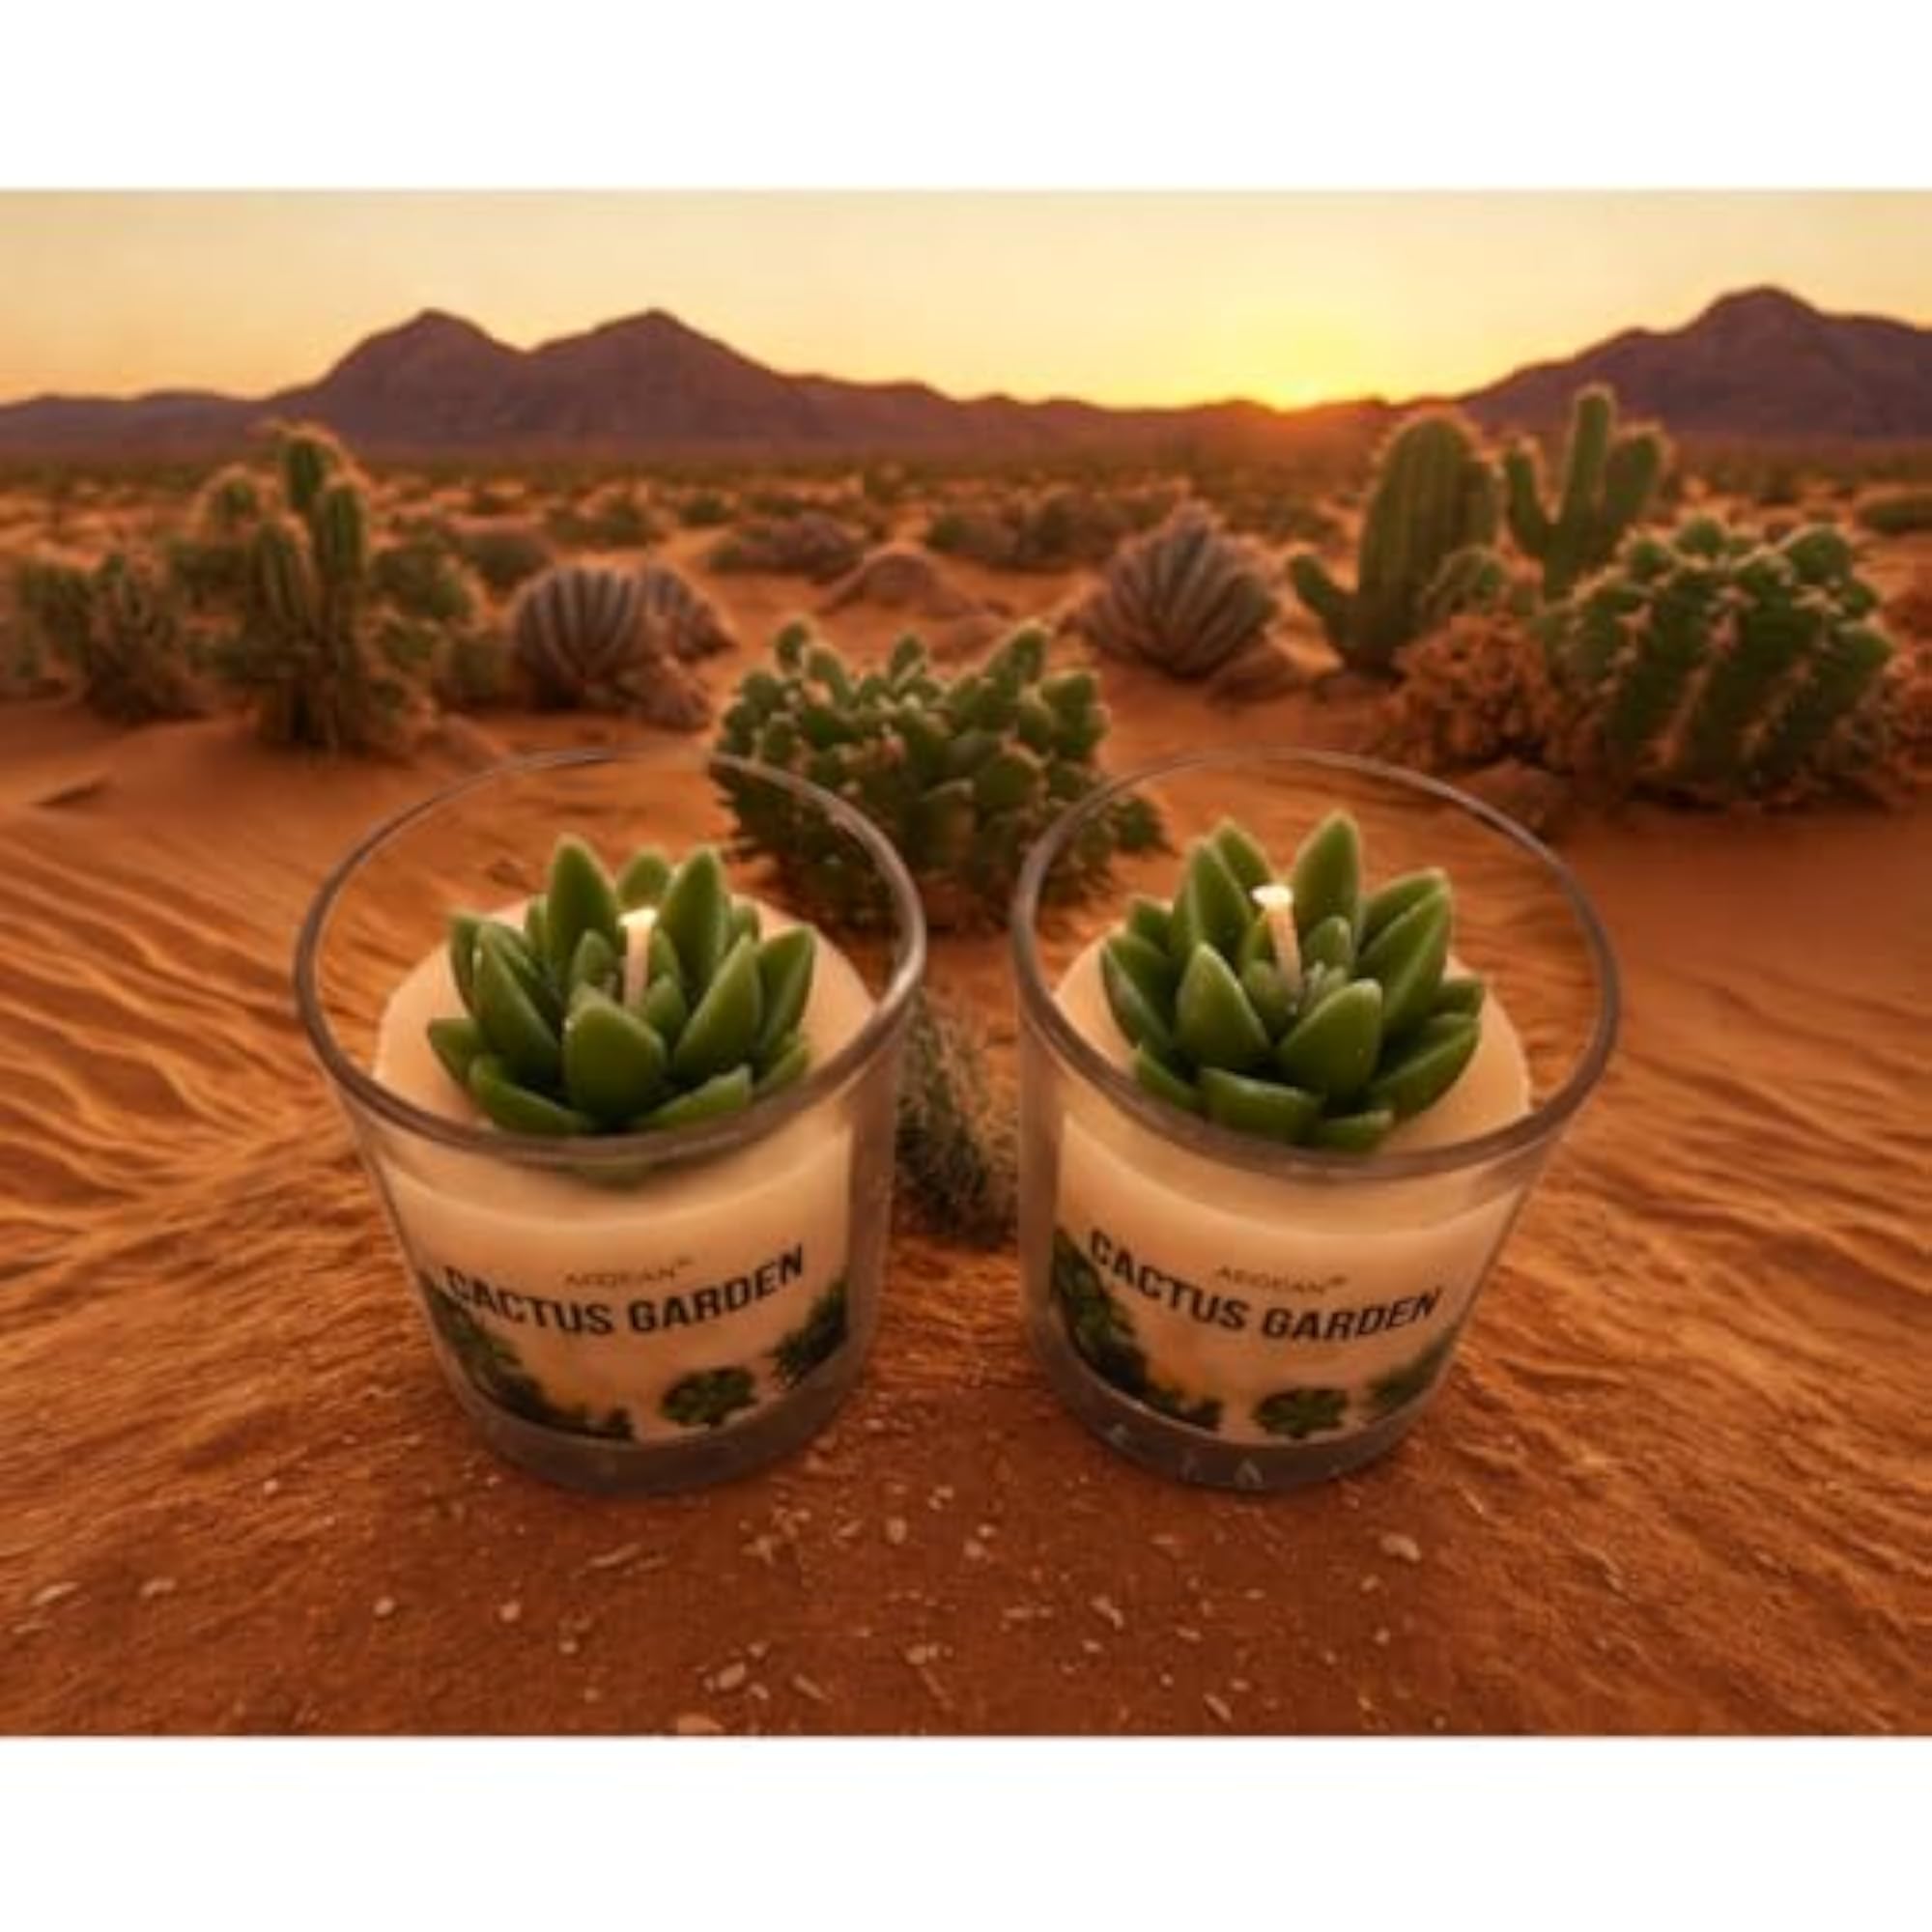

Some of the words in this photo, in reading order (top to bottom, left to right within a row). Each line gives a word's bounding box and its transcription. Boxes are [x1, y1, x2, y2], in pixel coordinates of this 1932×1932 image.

[442, 1264, 615, 1335] CACTUS
[628, 1243, 804, 1333] GARDEN
[1090, 1229, 1253, 1331] CACTUS
[1261, 1287, 1441, 1342] GARDEN
